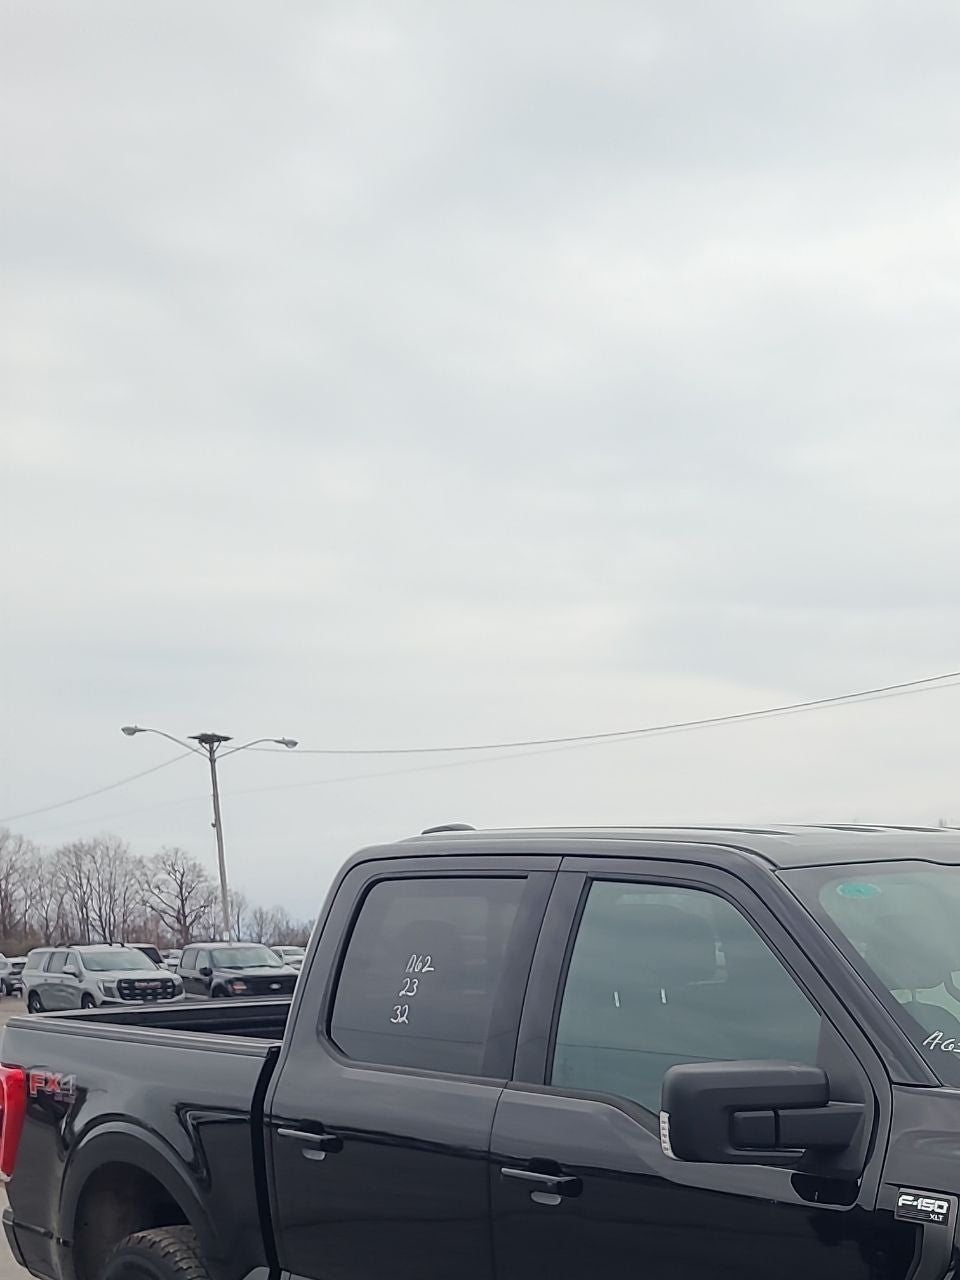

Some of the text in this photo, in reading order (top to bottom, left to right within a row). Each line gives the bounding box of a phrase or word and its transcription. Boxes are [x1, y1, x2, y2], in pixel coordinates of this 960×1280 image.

[399, 977, 419, 997] 23
[390, 1004, 409, 1024] 32
[29, 1070, 77, 1098] FX4
[898, 1194, 949, 1214] F-150
[929, 1213, 945, 1222] XLT
